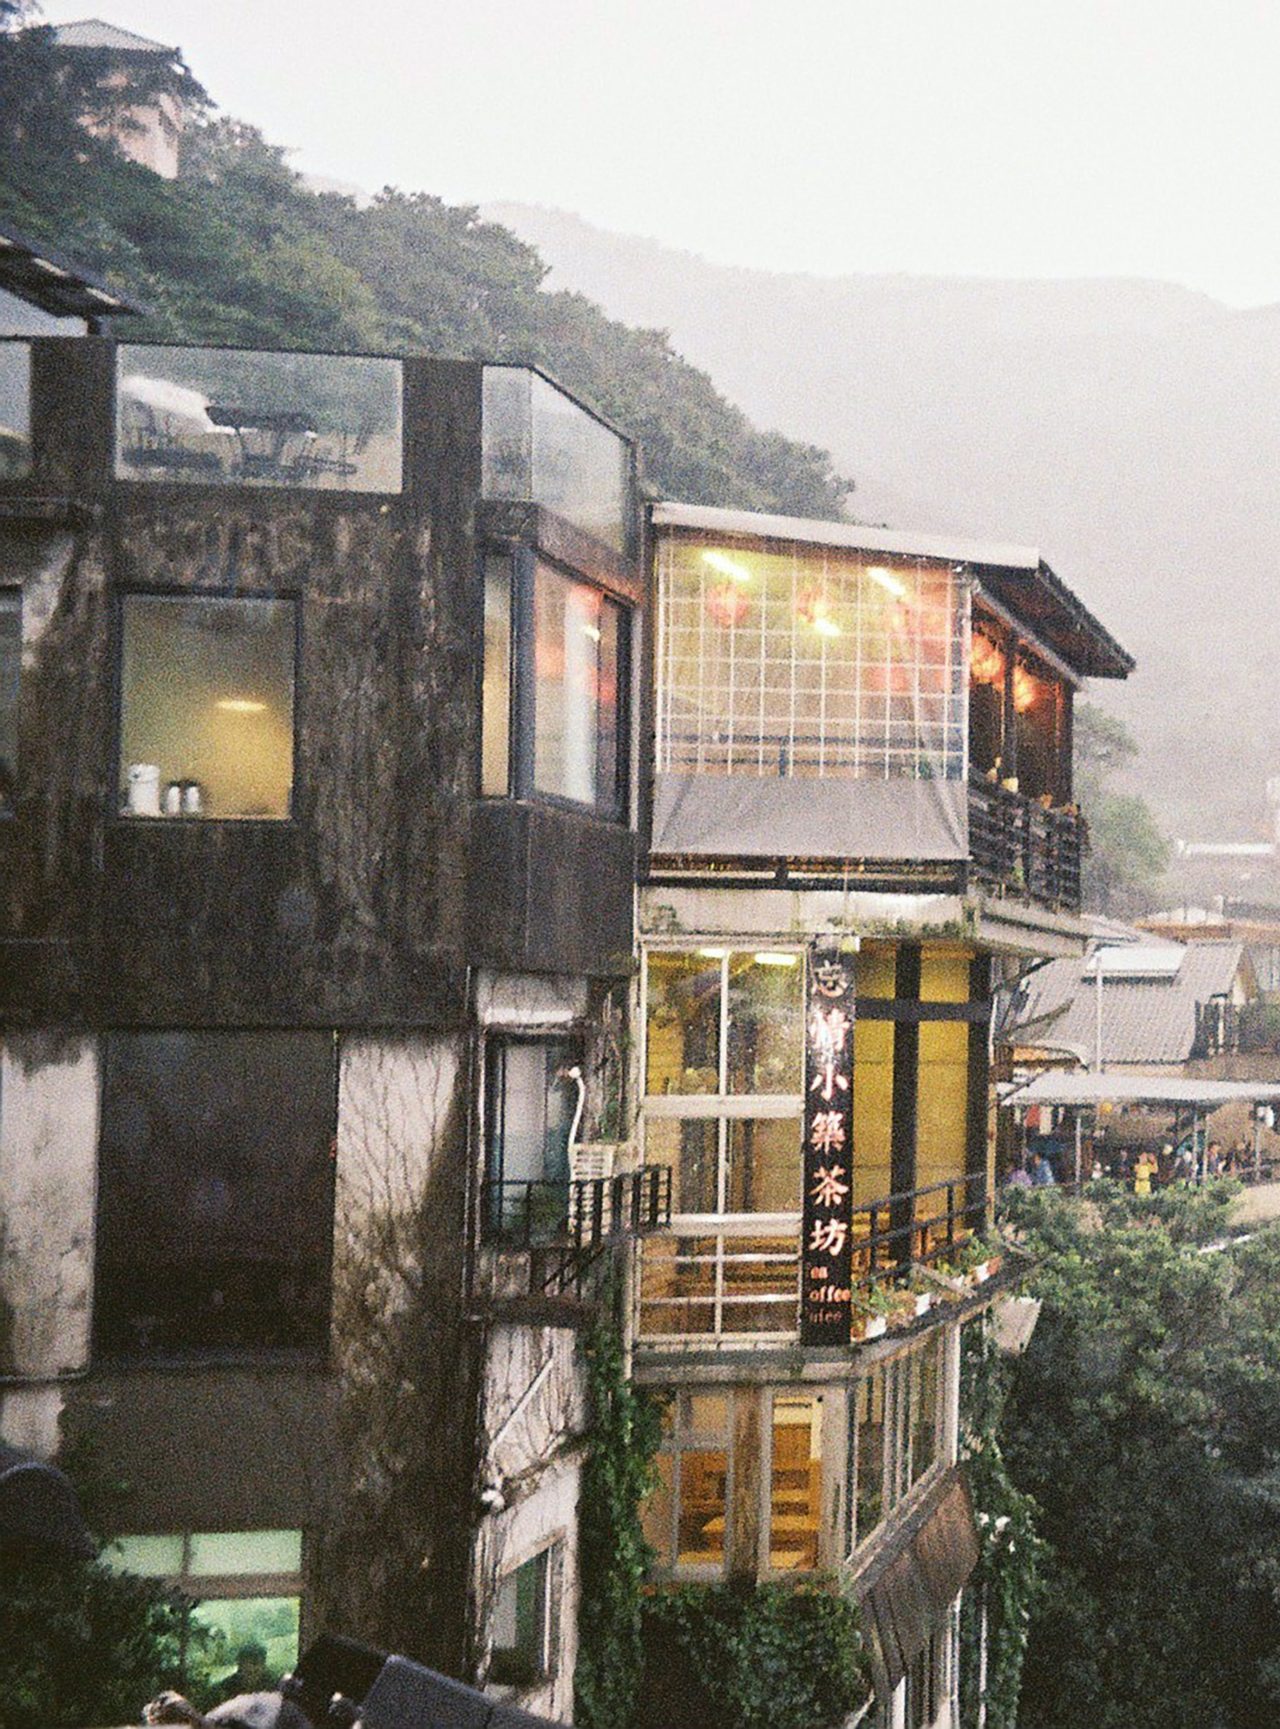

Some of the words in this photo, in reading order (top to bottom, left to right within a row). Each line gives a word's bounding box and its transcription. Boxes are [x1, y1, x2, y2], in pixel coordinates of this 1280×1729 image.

[809, 960, 850, 1257] 忘情小築茶坊
[808, 1284, 852, 1303] offee
